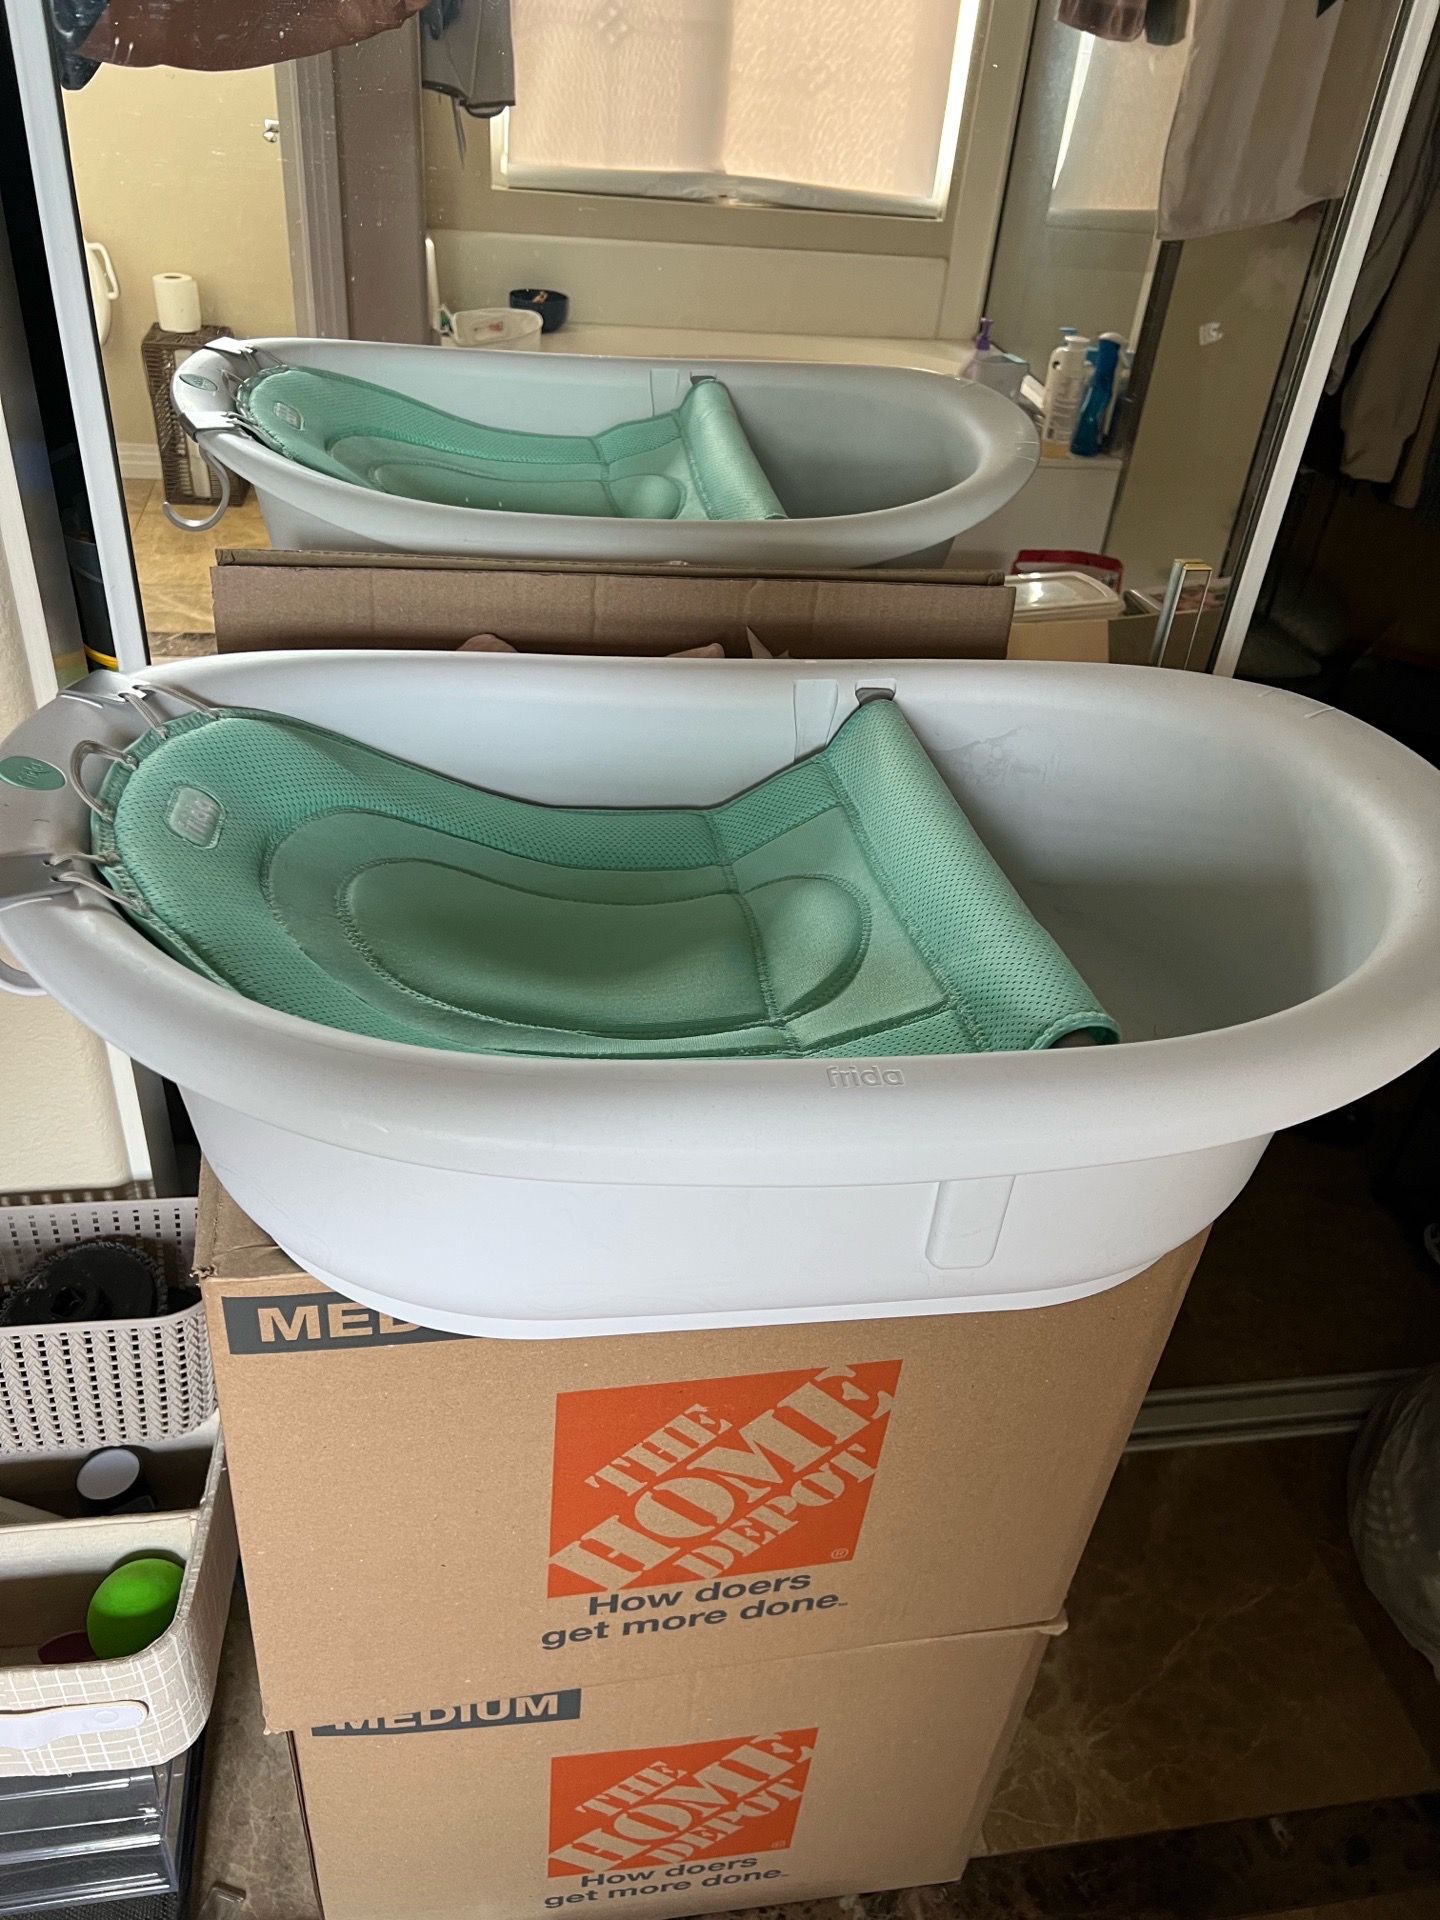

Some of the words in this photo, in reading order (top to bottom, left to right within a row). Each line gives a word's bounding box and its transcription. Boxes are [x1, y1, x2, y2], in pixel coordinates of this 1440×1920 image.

[826, 1065, 904, 1088] frida
[548, 1364, 895, 1592] HOME
[584, 1403, 733, 1497] THE
[672, 1443, 877, 1580] DEPOT
[588, 1590, 683, 1616] How
[695, 1574, 812, 1602] doers
[541, 1621, 610, 1650] get
[622, 1609, 728, 1635] more
[548, 1733, 814, 1872] HOME
[575, 1760, 687, 1817] THE
[645, 1778, 803, 1863] DEPOT
[544, 1888, 599, 1909] get
[608, 1879, 692, 1900] more
[581, 1869, 655, 1888] How
[665, 1857, 758, 1878] doers
